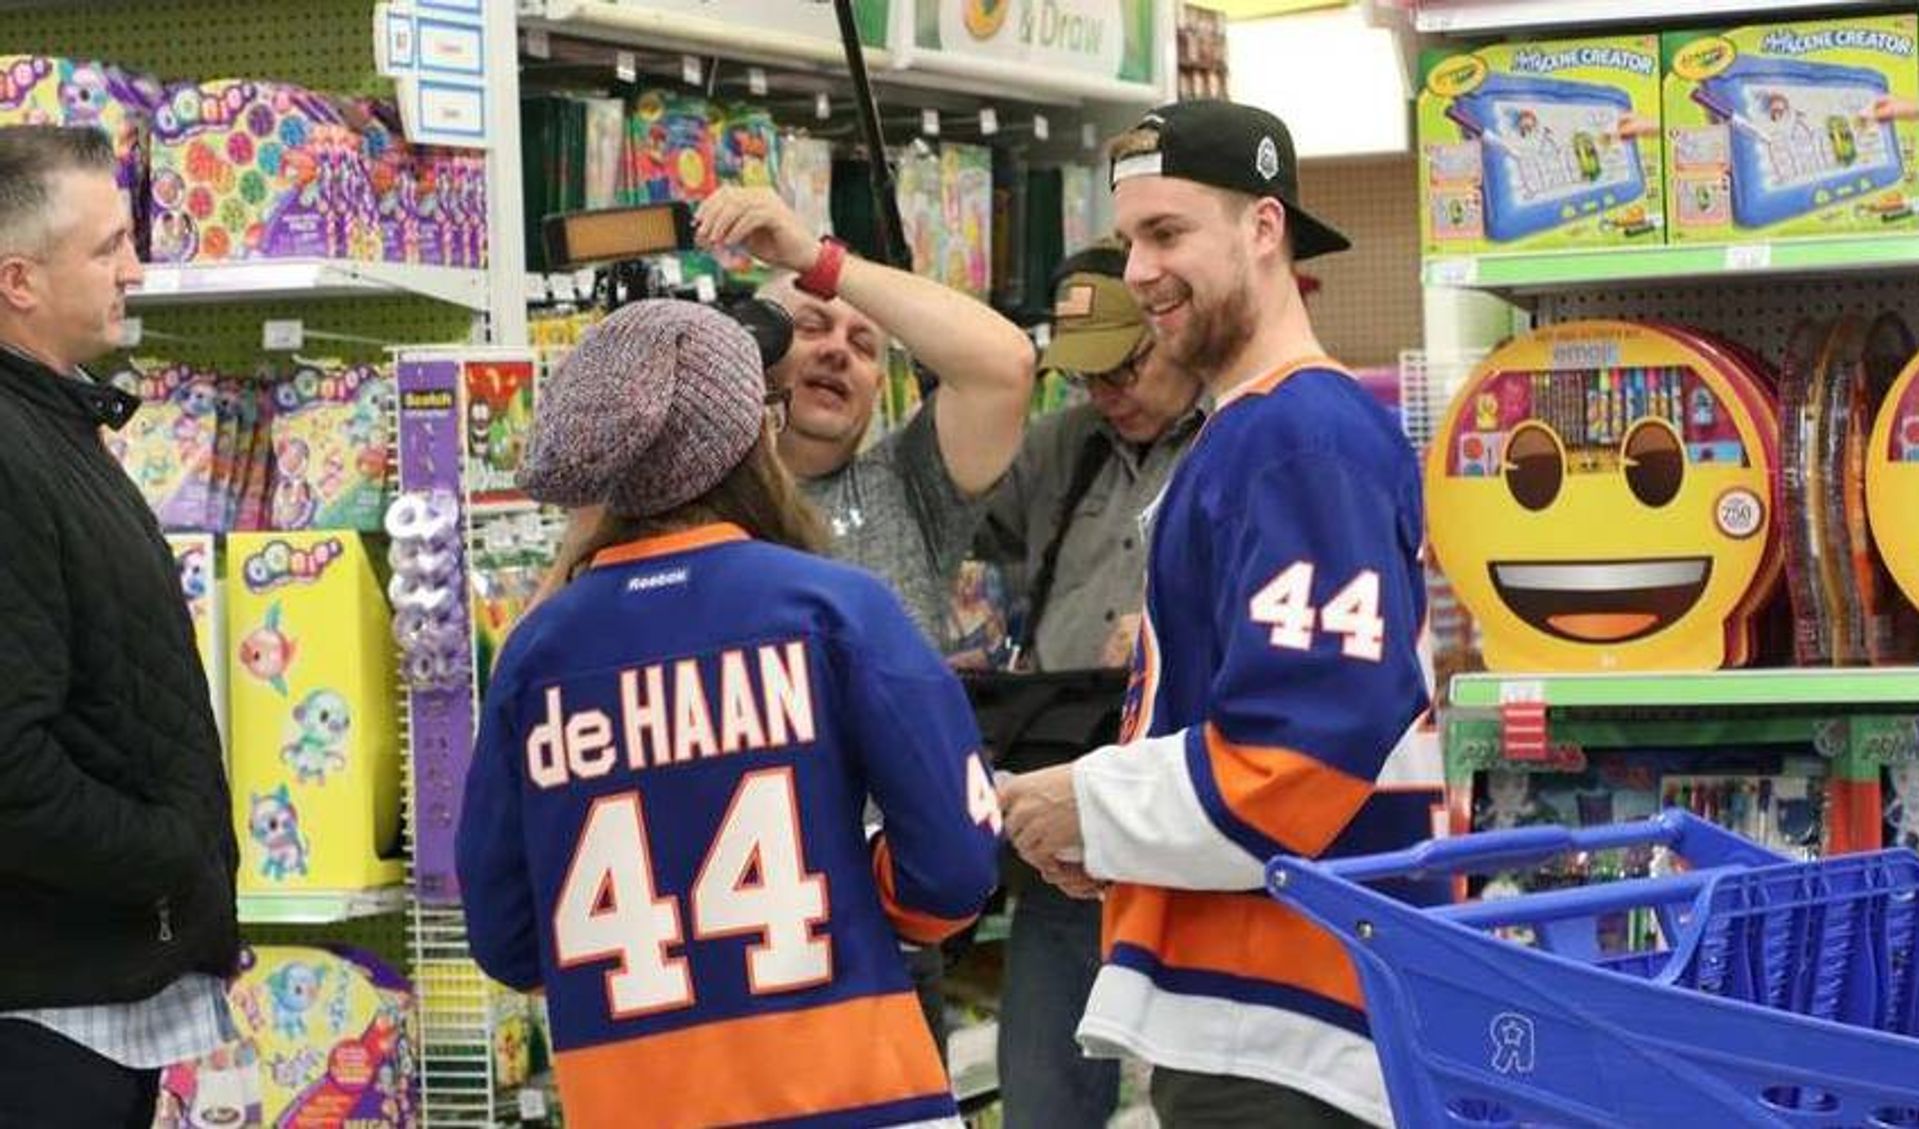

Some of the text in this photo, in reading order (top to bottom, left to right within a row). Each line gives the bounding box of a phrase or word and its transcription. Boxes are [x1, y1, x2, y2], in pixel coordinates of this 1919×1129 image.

[1039, 1, 1104, 54] Draw
[1834, 29, 1915, 57] CREATOR
[1580, 48, 1653, 74] CREATOR
[1552, 341, 1619, 367] emoji
[628, 567, 686, 591] Reebok
[1250, 559, 1384, 663] 44
[554, 765, 832, 1020] 44
